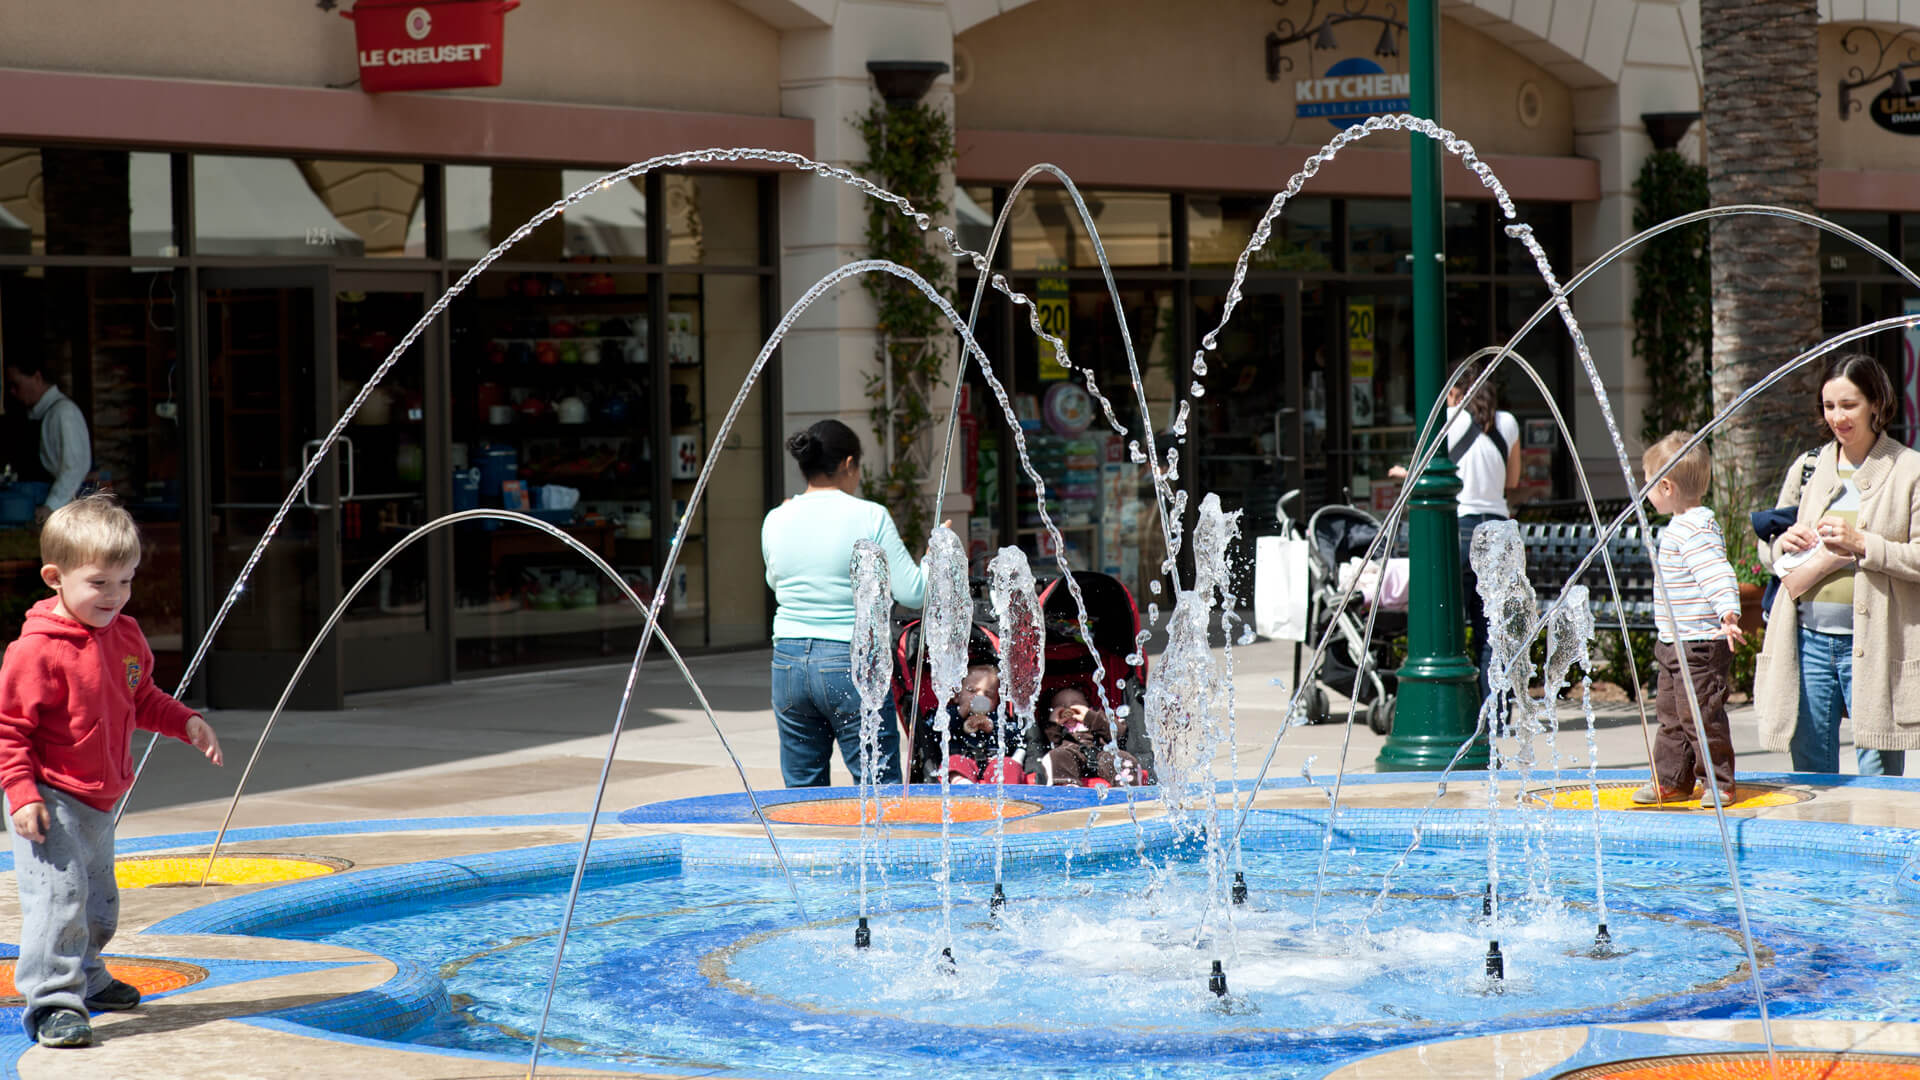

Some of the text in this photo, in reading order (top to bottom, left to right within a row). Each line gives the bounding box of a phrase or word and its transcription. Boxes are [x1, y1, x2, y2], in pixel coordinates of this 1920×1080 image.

[360, 44, 485, 67] LE CREUSET
[1296, 72, 1410, 101] KITCHEN
[305, 227, 337, 246] 125A
